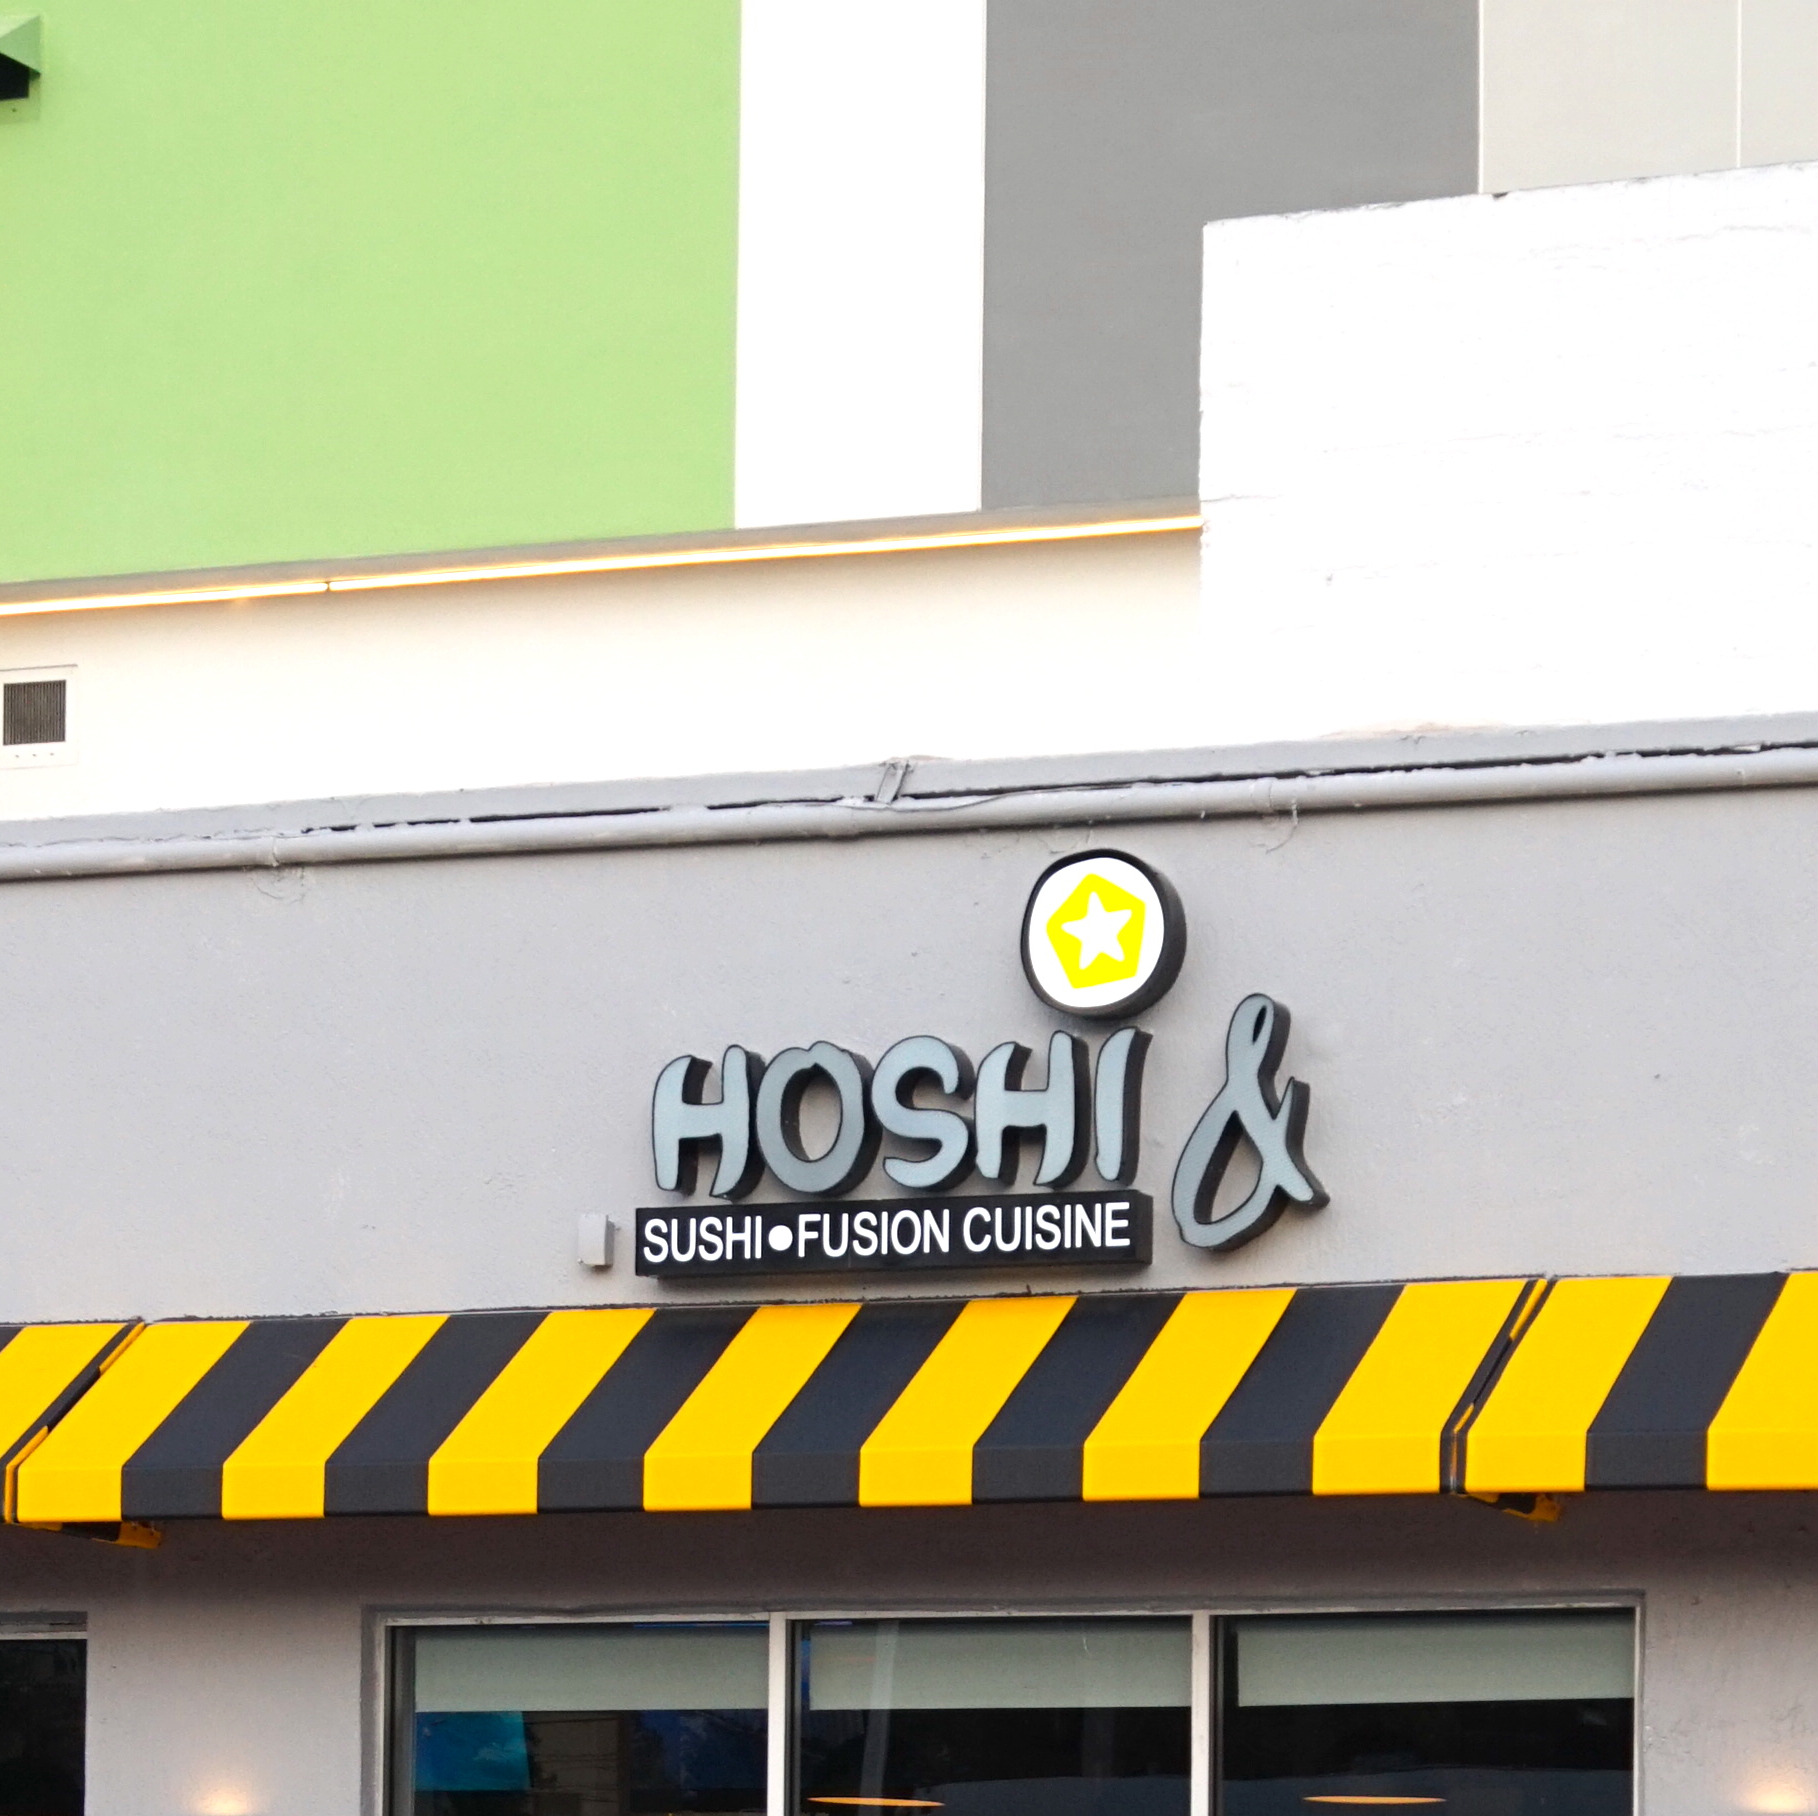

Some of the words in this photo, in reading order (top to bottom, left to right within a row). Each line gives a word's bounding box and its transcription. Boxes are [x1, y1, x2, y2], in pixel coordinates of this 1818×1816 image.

[652, 1026, 1147, 1198] HOSHI
[1172, 993, 1331, 1251] &
[962, 1201, 1131, 1252] CUISINE
